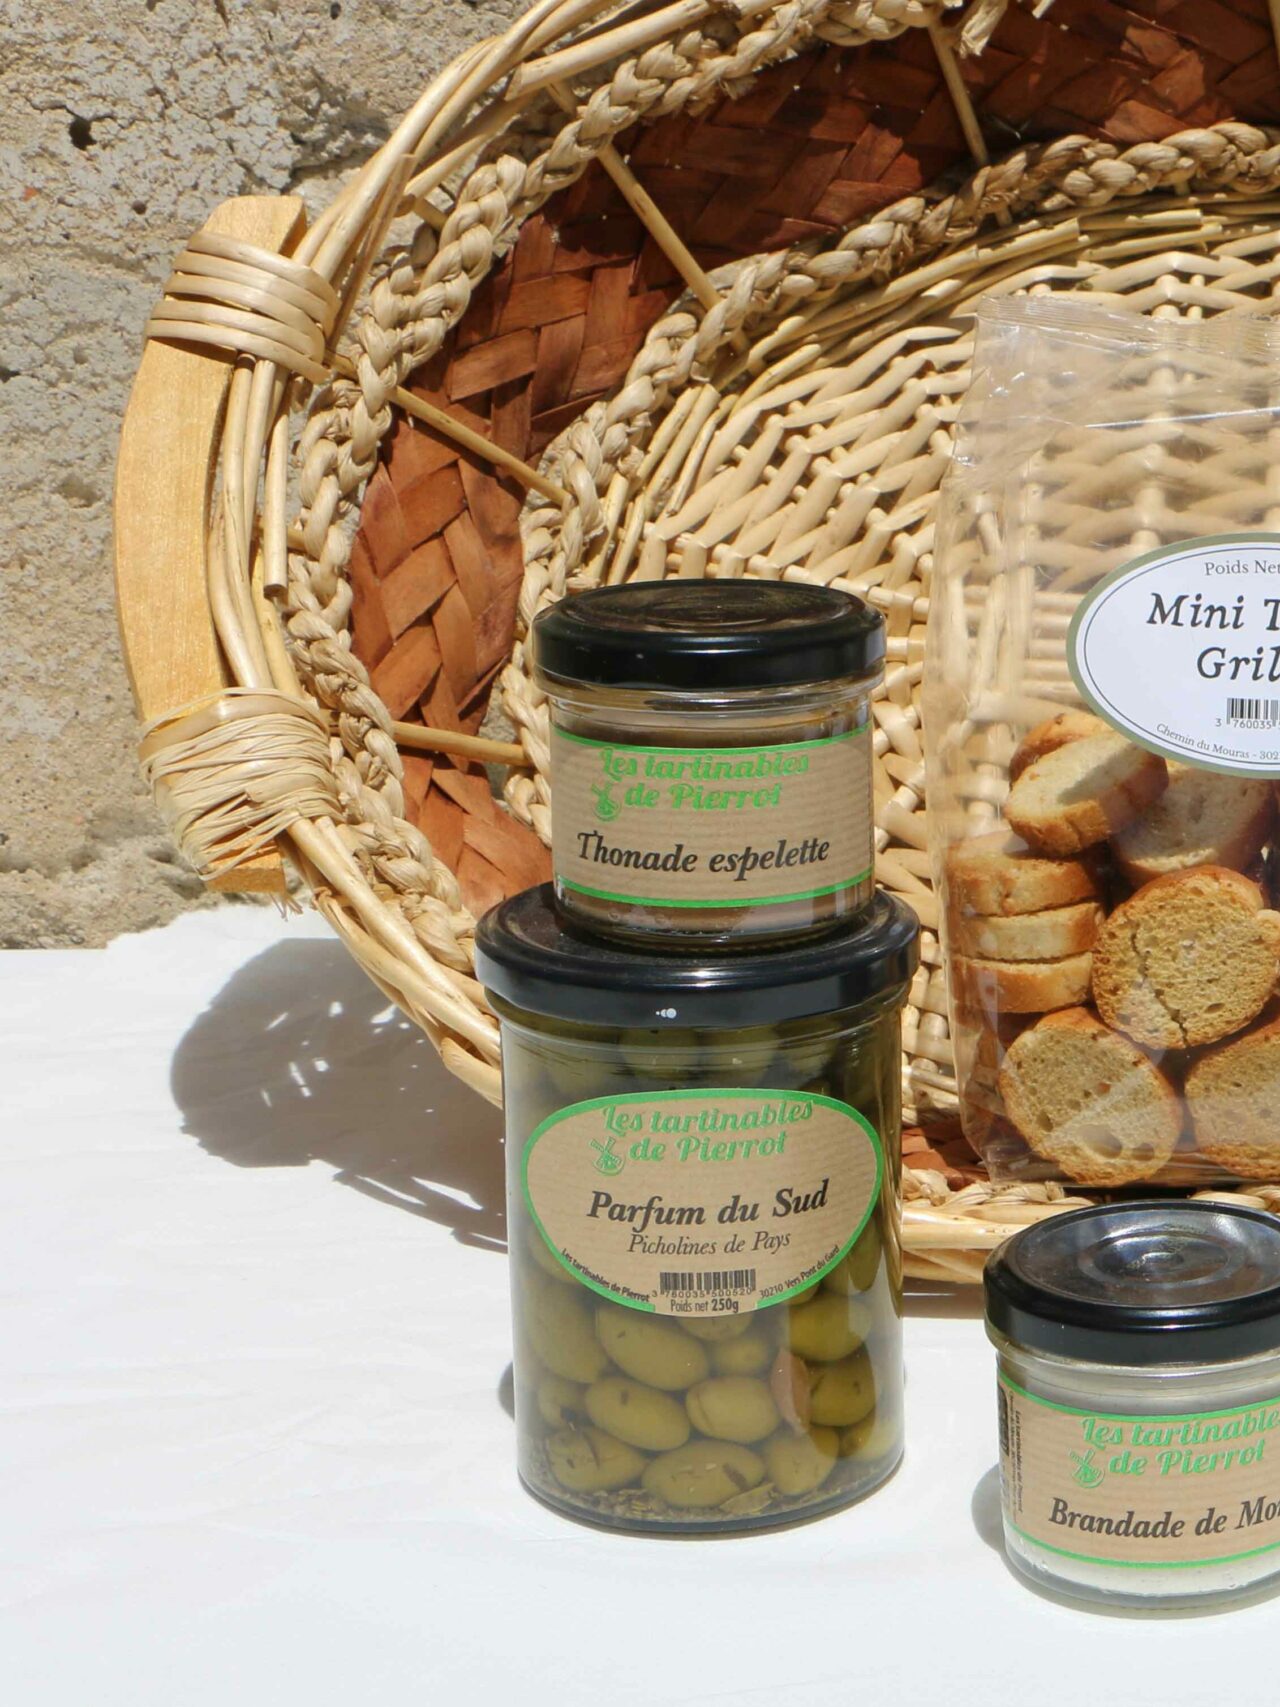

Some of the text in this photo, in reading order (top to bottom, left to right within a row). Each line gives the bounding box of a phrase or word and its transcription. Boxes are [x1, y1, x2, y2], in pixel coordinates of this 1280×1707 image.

[1204, 560, 1250, 577] Poids
[1146, 592, 1245, 630] Mini
[1215, 718, 1222, 728] 3
[1156, 723, 1195, 746] Chemin
[1197, 740, 1210, 751] du
[1212, 744, 1249, 759] Mouras
[599, 746, 810, 782] Les tartinables
[624, 783, 783, 811] de Pierrot
[577, 830, 830, 881] Thonade espelette
[602, 1100, 814, 1137] Les tartinables
[628, 1130, 788, 1162] de Pierrot
[586, 1179, 829, 1234] Parfum du Sud
[626, 1231, 791, 1256] Picholines de Pays
[759, 1283, 784, 1299] 30210
[784, 1276, 801, 1288] Vers
[800, 1265, 817, 1280] Pont
[670, 1298, 739, 1313] Poids net 250g
[1079, 1415, 1123, 1450] Les
[1108, 1438, 1266, 1476] de Pierrot
[1048, 1496, 1184, 1538] Brandade
[1194, 1507, 1228, 1536] de
